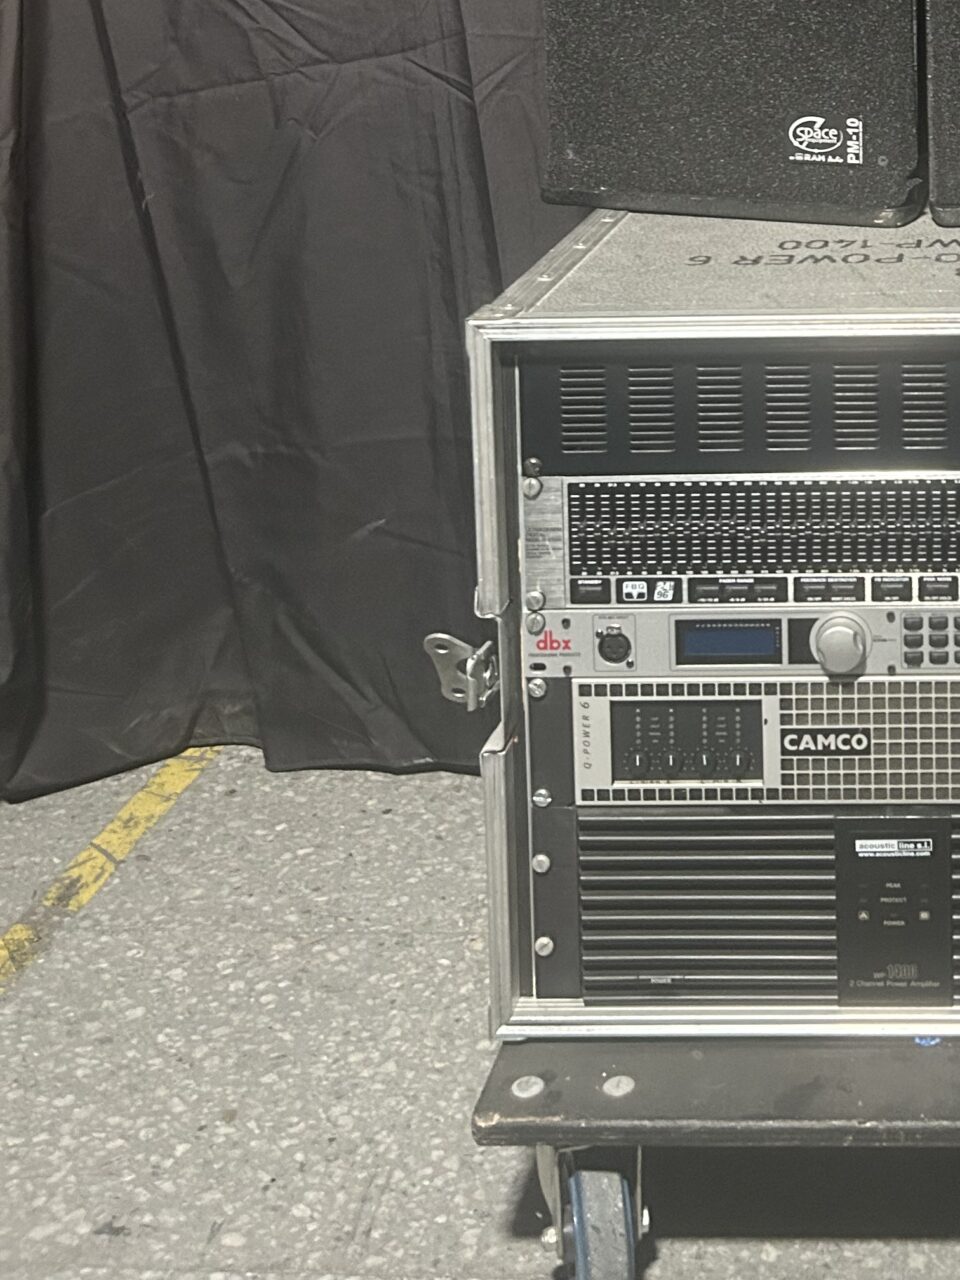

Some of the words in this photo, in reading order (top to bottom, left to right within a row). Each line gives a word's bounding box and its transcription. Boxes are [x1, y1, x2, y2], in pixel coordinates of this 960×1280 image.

[846, 117, 862, 164] PM-10
[684, 255, 713, 266] 6
[536, 629, 571, 651] dbx
[580, 701, 590, 710] 6
[783, 733, 868, 751] CAMCO
[859, 841, 896, 850] acoustic
[899, 841, 915, 849] line
